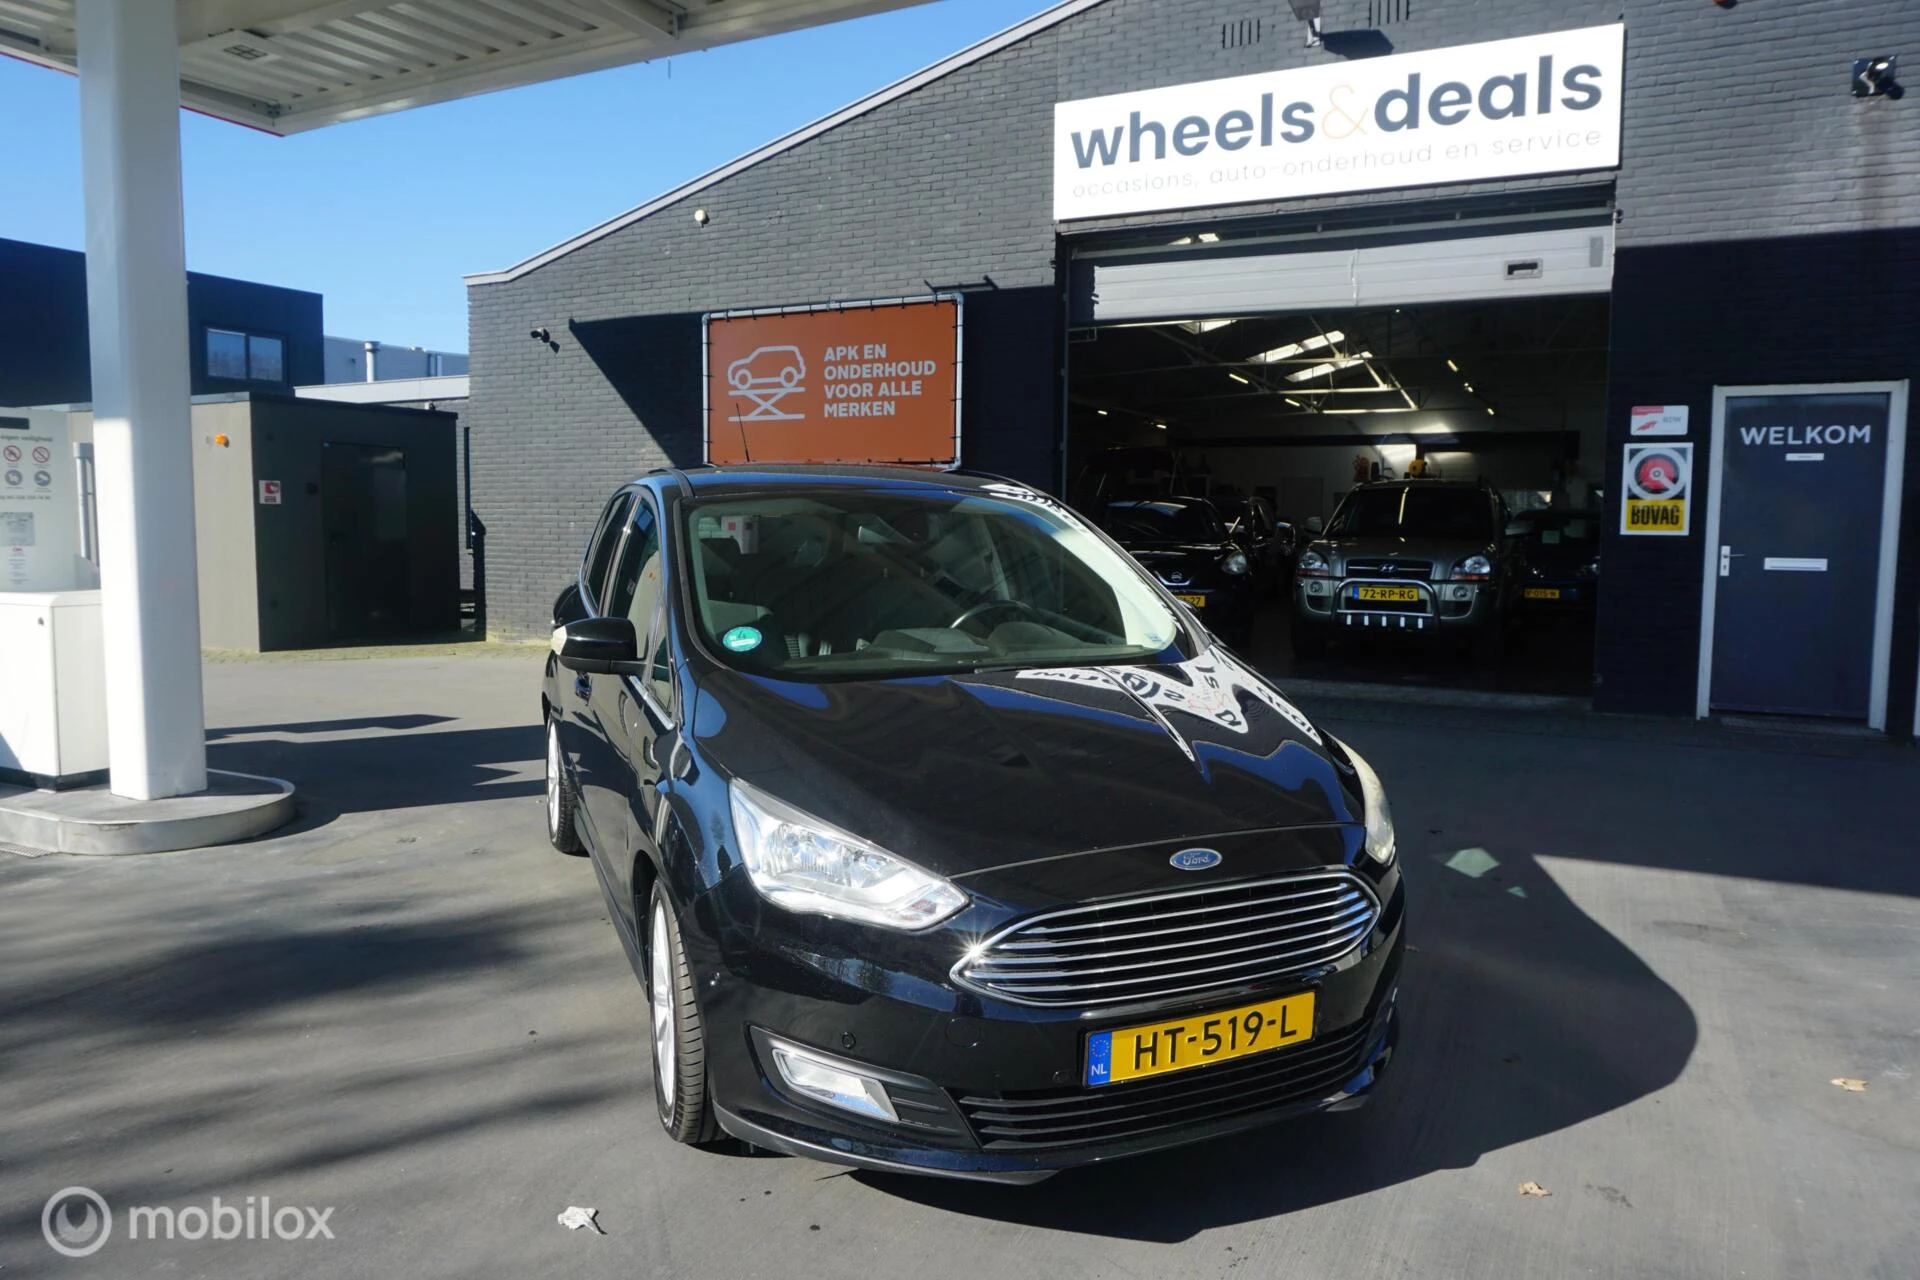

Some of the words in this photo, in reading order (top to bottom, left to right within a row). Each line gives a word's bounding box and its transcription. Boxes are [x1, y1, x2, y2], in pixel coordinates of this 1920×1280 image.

[1072, 171, 1201, 199] occasions,
[1209, 143, 1433, 184] auto-onderhoud
[1445, 141, 1479, 159] en
[1491, 128, 1601, 156] service
[824, 345, 860, 361] APK
[863, 343, 887, 360] EN
[824, 360, 937, 381] ONDERHOUD
[824, 382, 874, 400] VOOR
[878, 380, 923, 397] ALLE
[824, 400, 896, 418] MERKEN
[1740, 425, 1871, 446] WELKOM
[1631, 504, 1680, 526] BOVAG
[1362, 588, 1414, 600] 72-RP-RG
[1134, 1005, 1297, 1070] HT-519-L
[1091, 1063, 1107, 1077] NL
